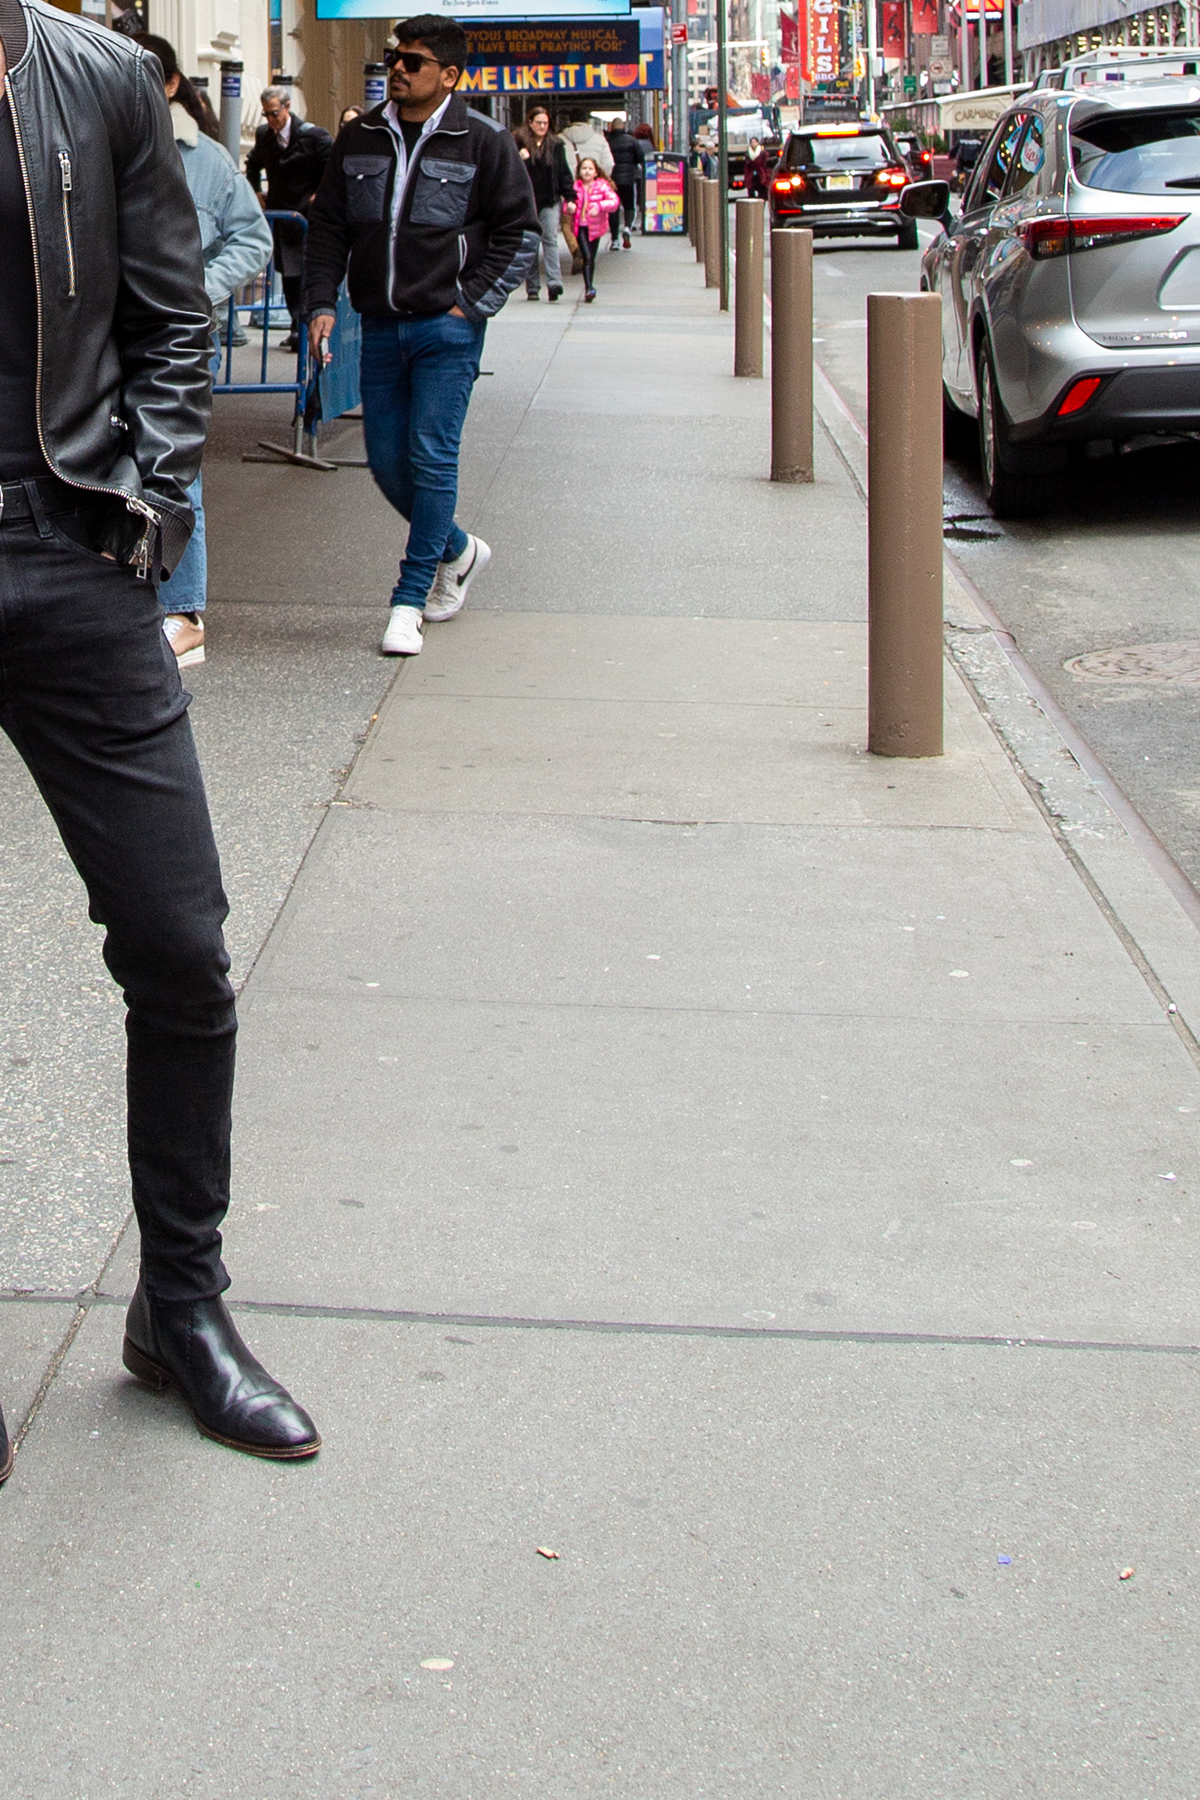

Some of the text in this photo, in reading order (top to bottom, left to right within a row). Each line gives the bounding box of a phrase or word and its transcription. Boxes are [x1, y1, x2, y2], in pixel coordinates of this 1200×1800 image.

[505, 29, 568, 41] BROADWAY
[478, 41, 505, 53] HAVE
[509, 41, 537, 52] BEEN
[540, 40, 591, 52] PRAYING
